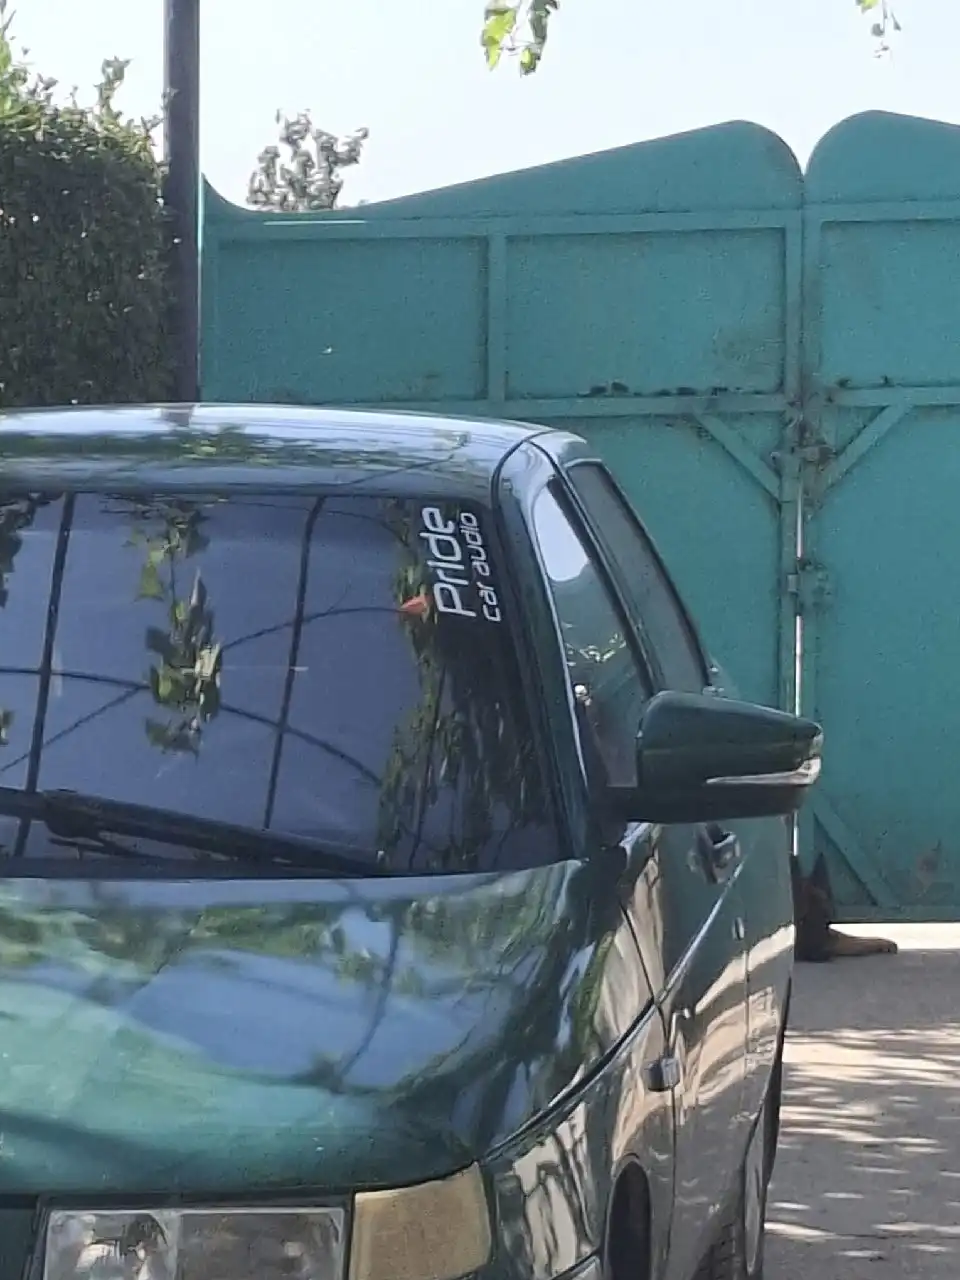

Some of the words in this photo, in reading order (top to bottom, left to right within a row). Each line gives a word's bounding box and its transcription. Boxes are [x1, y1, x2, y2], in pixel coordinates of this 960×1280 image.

[420, 507, 476, 617] Pride
[460, 512, 490, 576] audio
[476, 582, 501, 622] car
